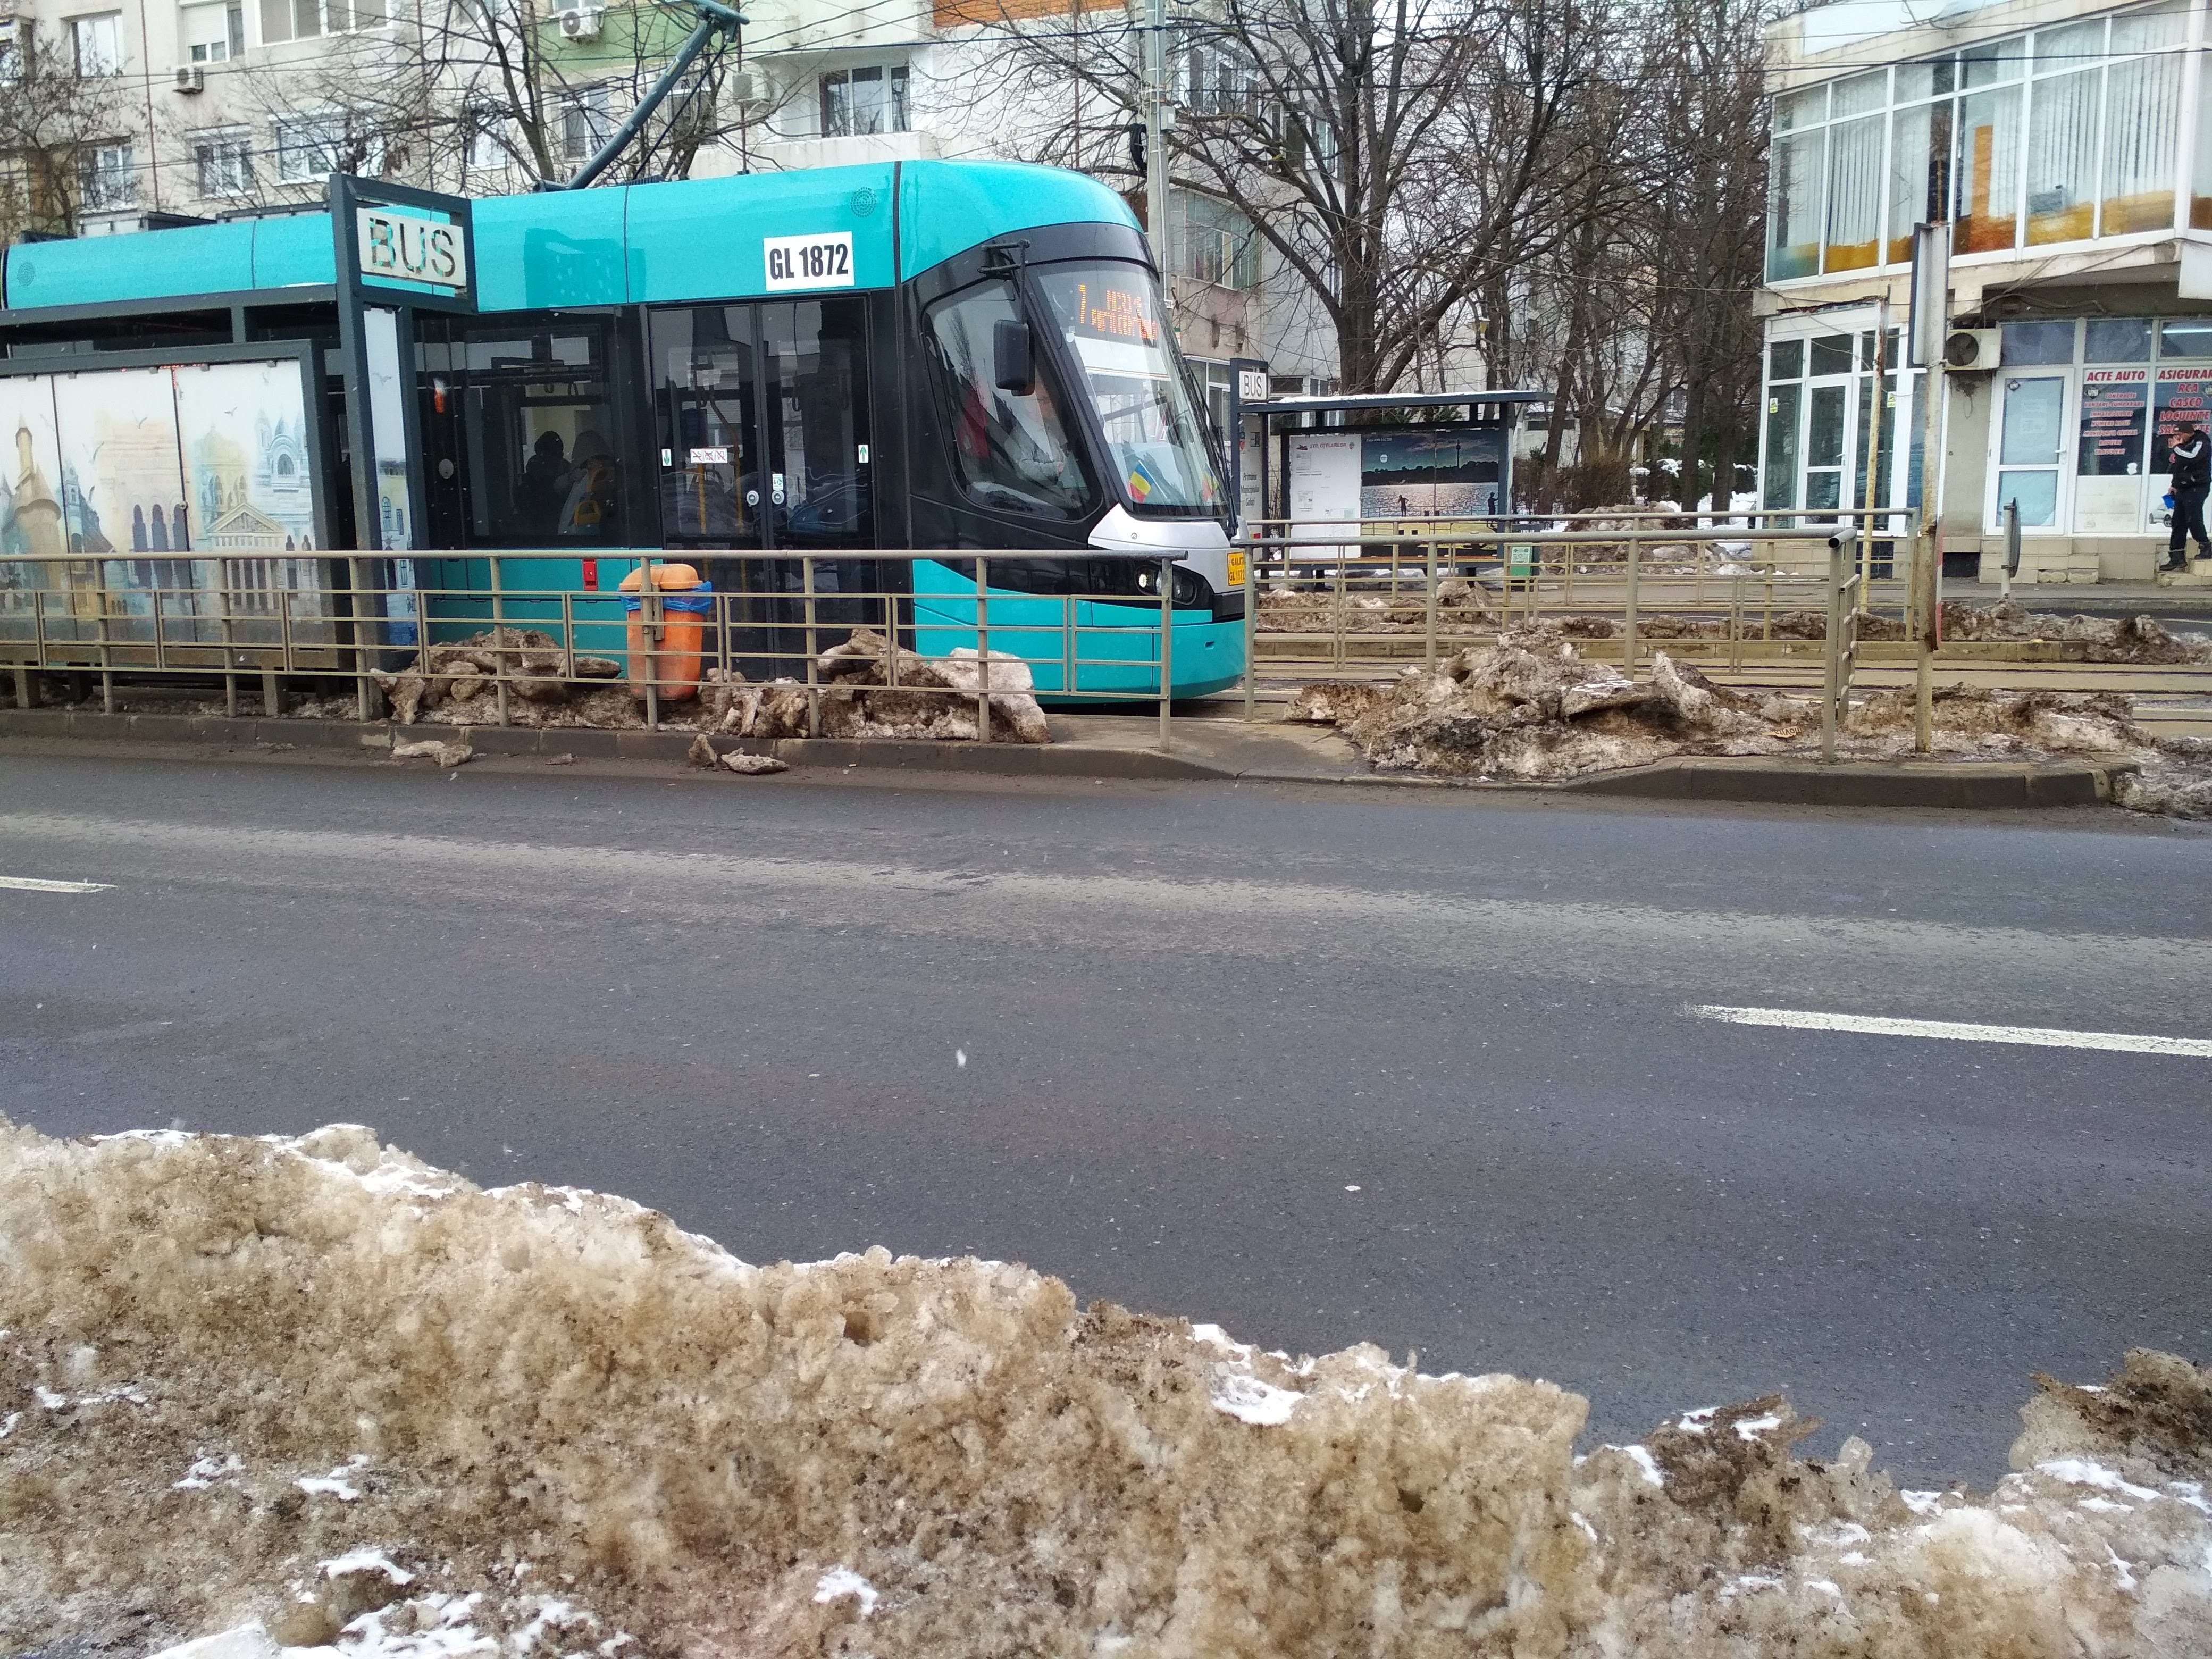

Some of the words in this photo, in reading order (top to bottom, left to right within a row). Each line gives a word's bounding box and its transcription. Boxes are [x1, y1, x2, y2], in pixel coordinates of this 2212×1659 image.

[370, 217, 456, 277] BUS
[769, 248, 795, 280] GL
[799, 243, 849, 278] 1872
[2087, 372, 2113, 381] ACTE
[2115, 371, 2146, 381] AUTO
[1244, 374, 1262, 397] BUS
[2177, 383, 2199, 393] RCA
[2169, 397, 2203, 407] CASCO
[2159, 410, 2211, 422] LOCUINTE
[1229, 571, 1235, 581] GL
